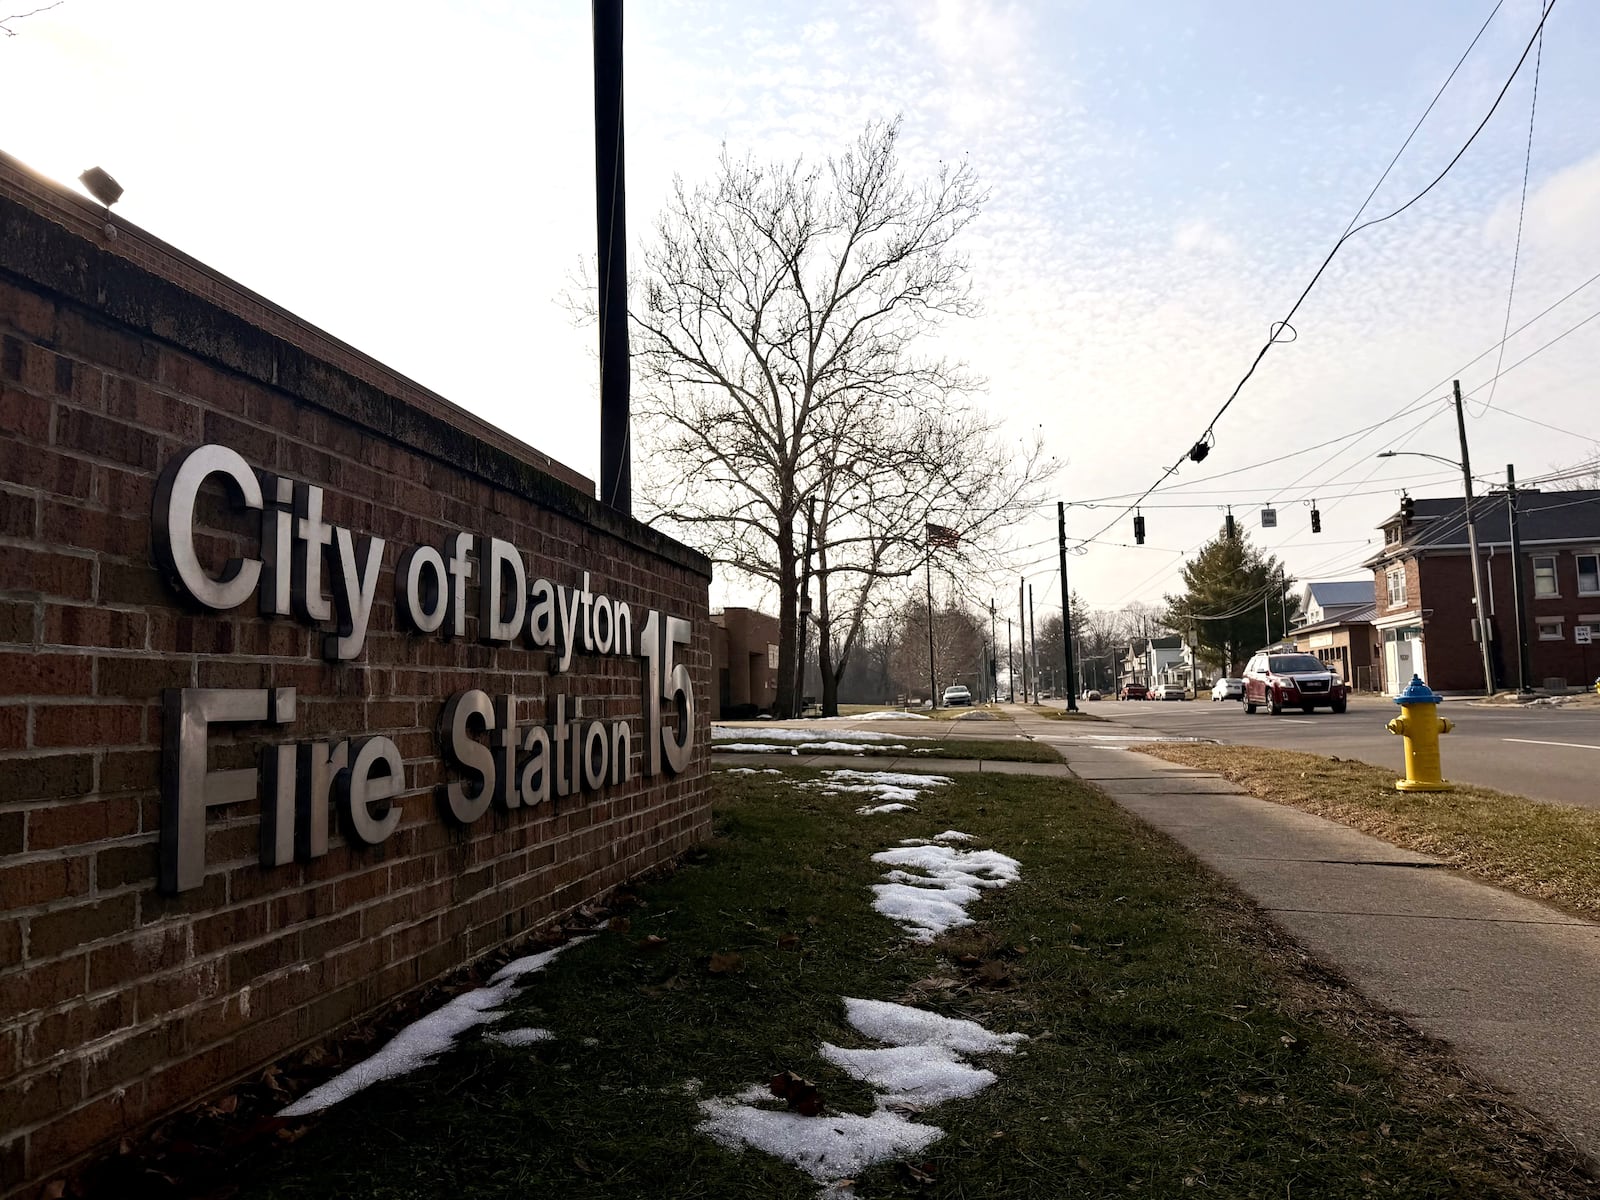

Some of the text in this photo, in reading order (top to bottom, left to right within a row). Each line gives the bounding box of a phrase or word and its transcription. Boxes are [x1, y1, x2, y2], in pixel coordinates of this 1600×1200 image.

[168, 443, 632, 673] City of Dayton
[176, 610, 695, 893] Fire Station 15
